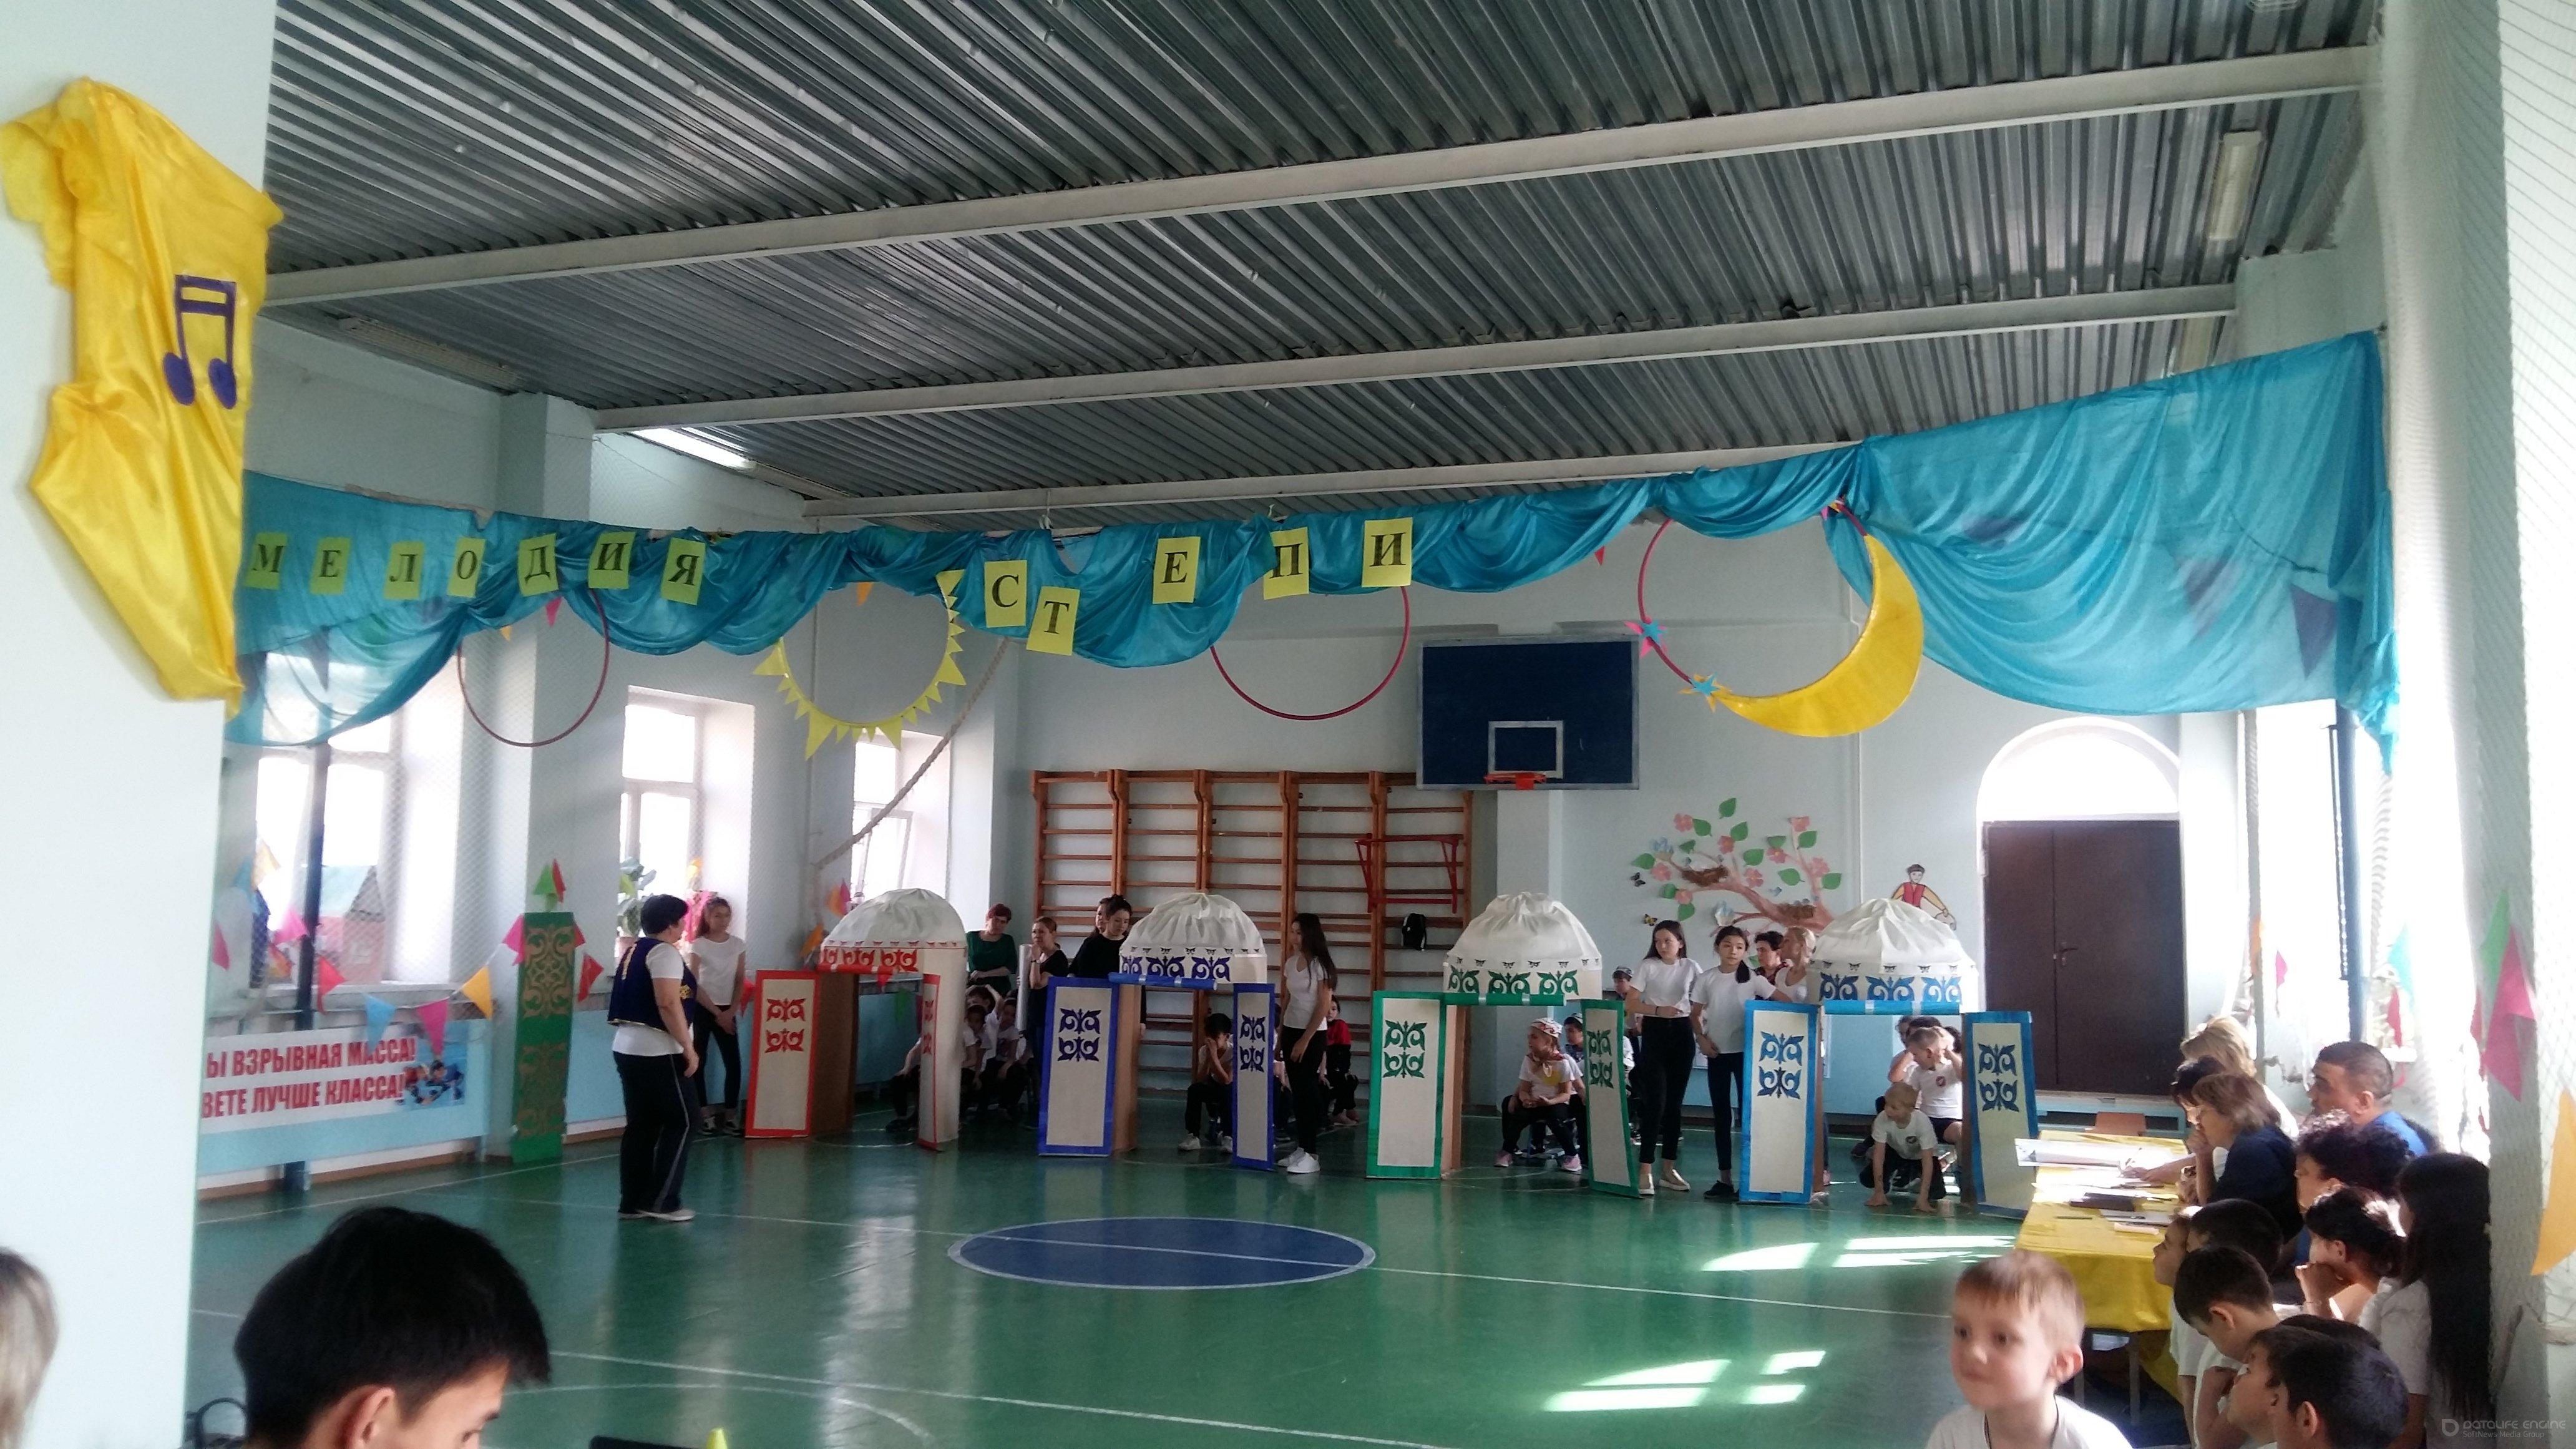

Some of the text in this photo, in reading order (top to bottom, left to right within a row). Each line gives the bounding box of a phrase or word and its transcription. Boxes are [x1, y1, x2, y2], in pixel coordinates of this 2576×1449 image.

[232, 1043, 343, 1076] ВЗРЫВНАЯ
[251, 1081, 321, 1113] ЛУЧШЕ
[324, 1073, 404, 1105] КЛАССА!
